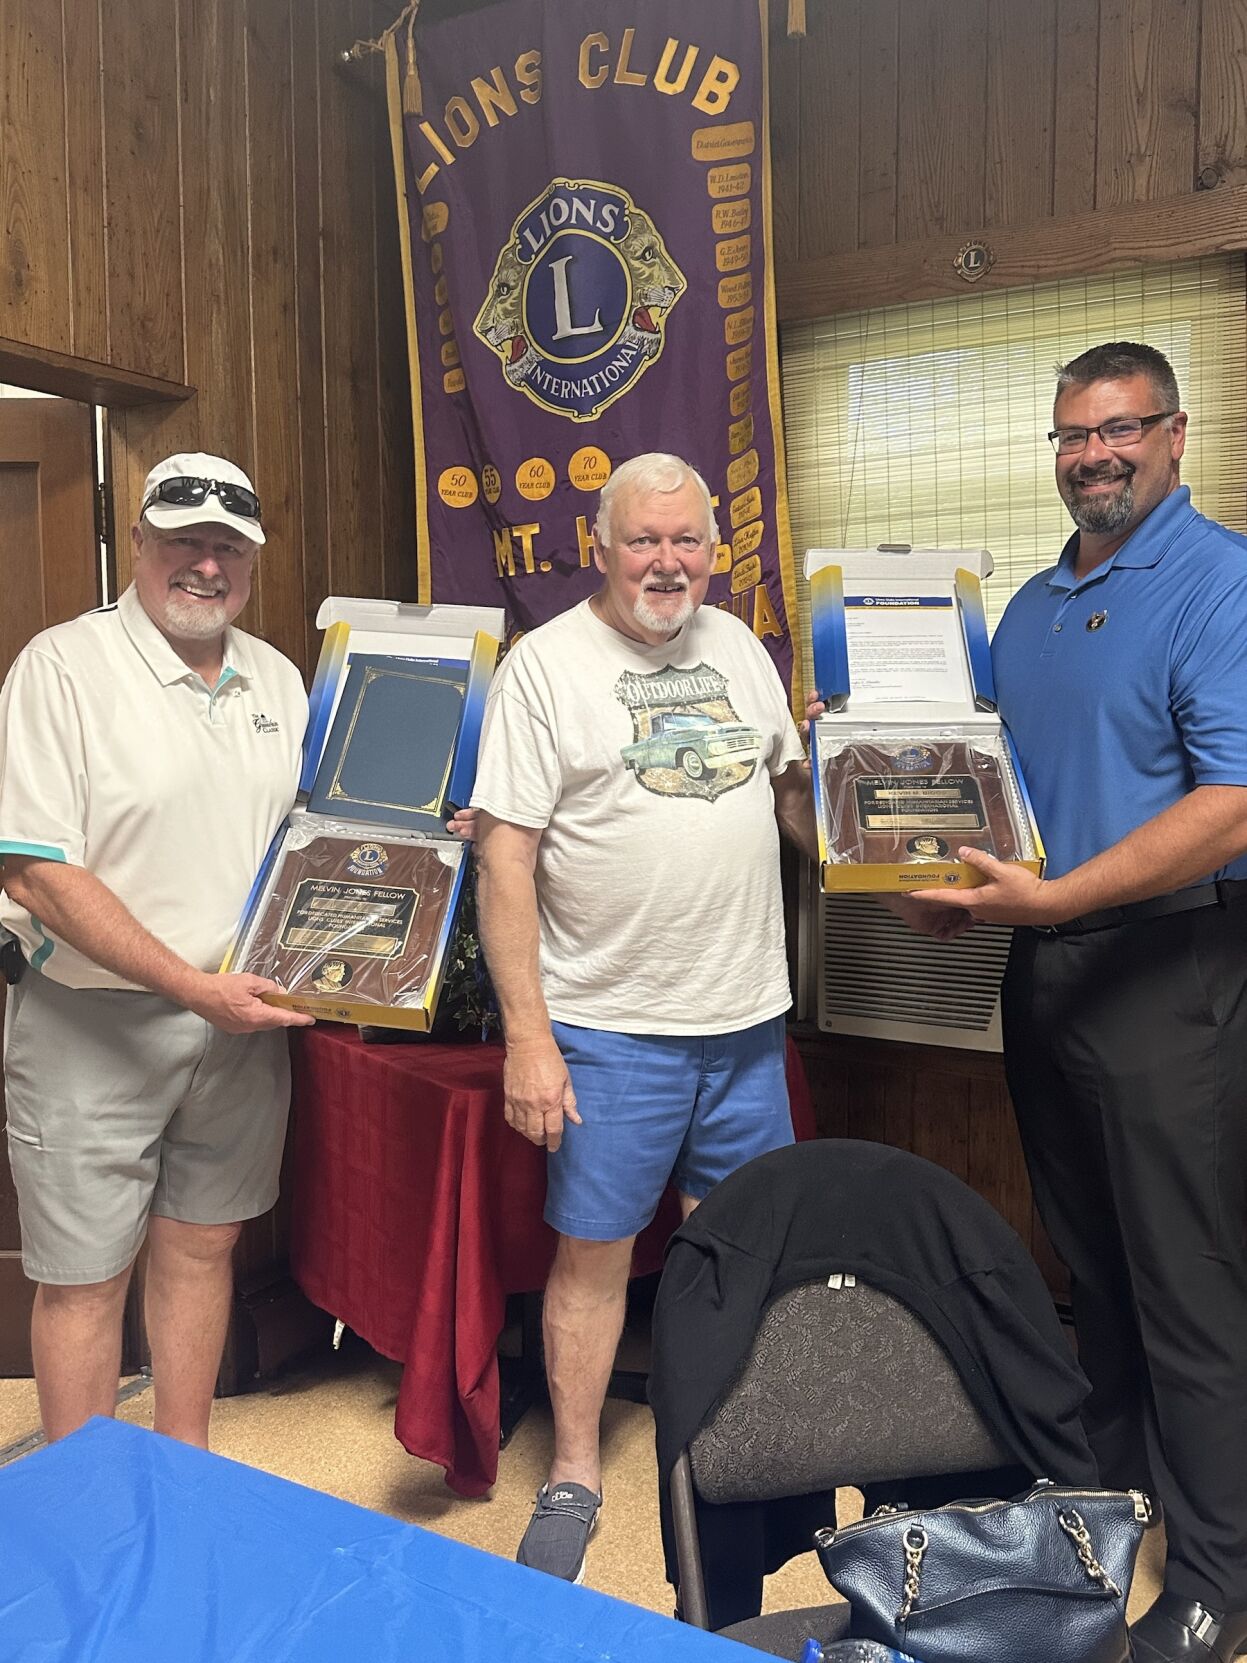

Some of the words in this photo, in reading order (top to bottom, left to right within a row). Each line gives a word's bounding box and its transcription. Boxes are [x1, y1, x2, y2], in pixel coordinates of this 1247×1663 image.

[415, 49, 542, 195] LIONS
[578, 28, 741, 116] CLUB
[523, 197, 620, 251] LIONS
[969, 251, 981, 268] L
[549, 255, 604, 342] L
[528, 340, 642, 399] INTERNATIONAL
[583, 456, 597, 470] 70
[484, 468, 497, 487] 55
[529, 465, 545, 478] 60
[574, 474, 590, 482] YEAR
[591, 472, 607, 481] CLUB
[450, 473, 467, 487] 50
[519, 482, 534, 490] YEAR
[535, 481, 551, 489] CLUB
[441, 489, 457, 497] YEAR
[457, 490, 474, 499] CLUB
[492, 522, 553, 578] MT.
[364, 850, 374, 861] L
[310, 885, 341, 894] MELVIN
[343, 887, 371, 897] JONES
[373, 890, 406, 900] FELLOW
